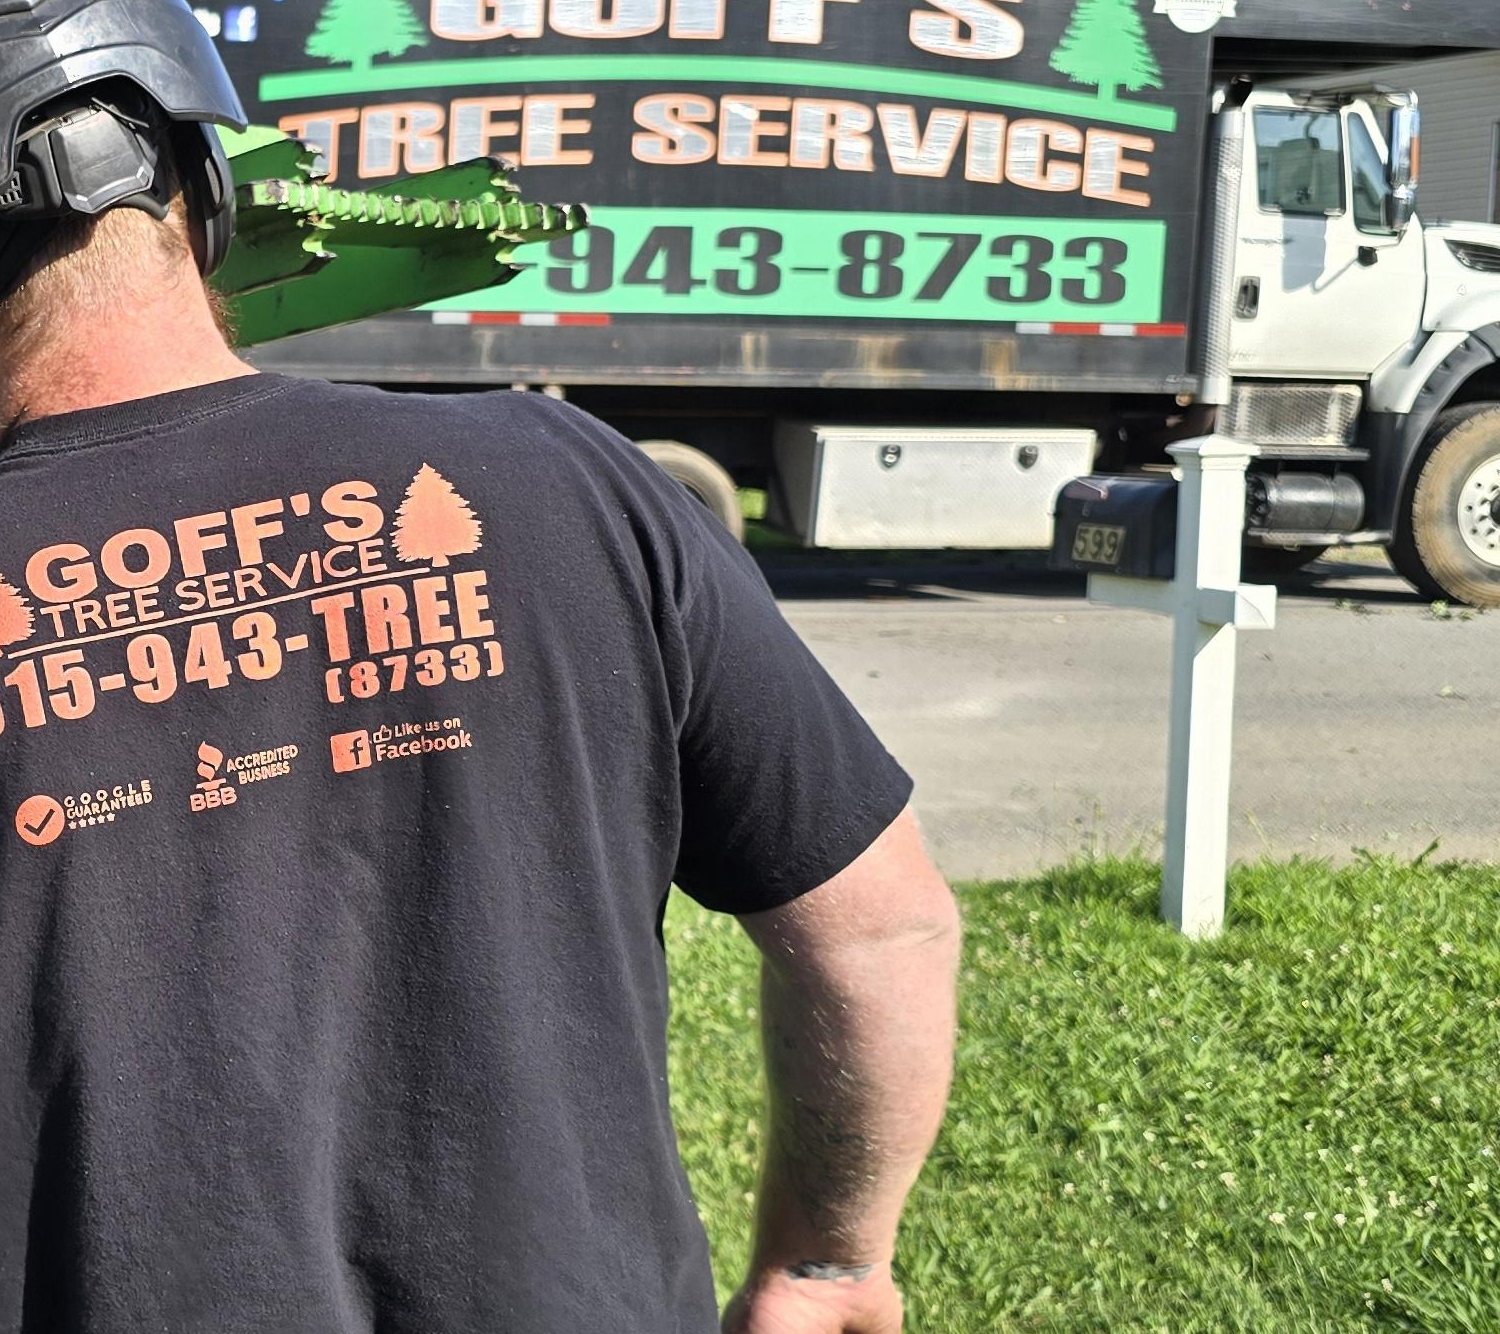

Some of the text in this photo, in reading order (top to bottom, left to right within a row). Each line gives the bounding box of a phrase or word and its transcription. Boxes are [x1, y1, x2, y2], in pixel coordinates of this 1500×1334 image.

[278, 93, 1156, 208] TREE SERVICE
[514, 224, 1130, 306] -943-8733
[25, 480, 385, 604] GOFF'S
[1074, 528, 1119, 563] 599
[40, 538, 388, 638] TREE SERVICE
[394, 717, 461, 738] Like us on
[226, 744, 299, 773] ACCREDITED
[376, 729, 473, 762] Facebook
[238, 760, 291, 785] BUSINESS
[66, 791, 153, 820] GUARANTEED
[190, 786, 238, 812] BBB
